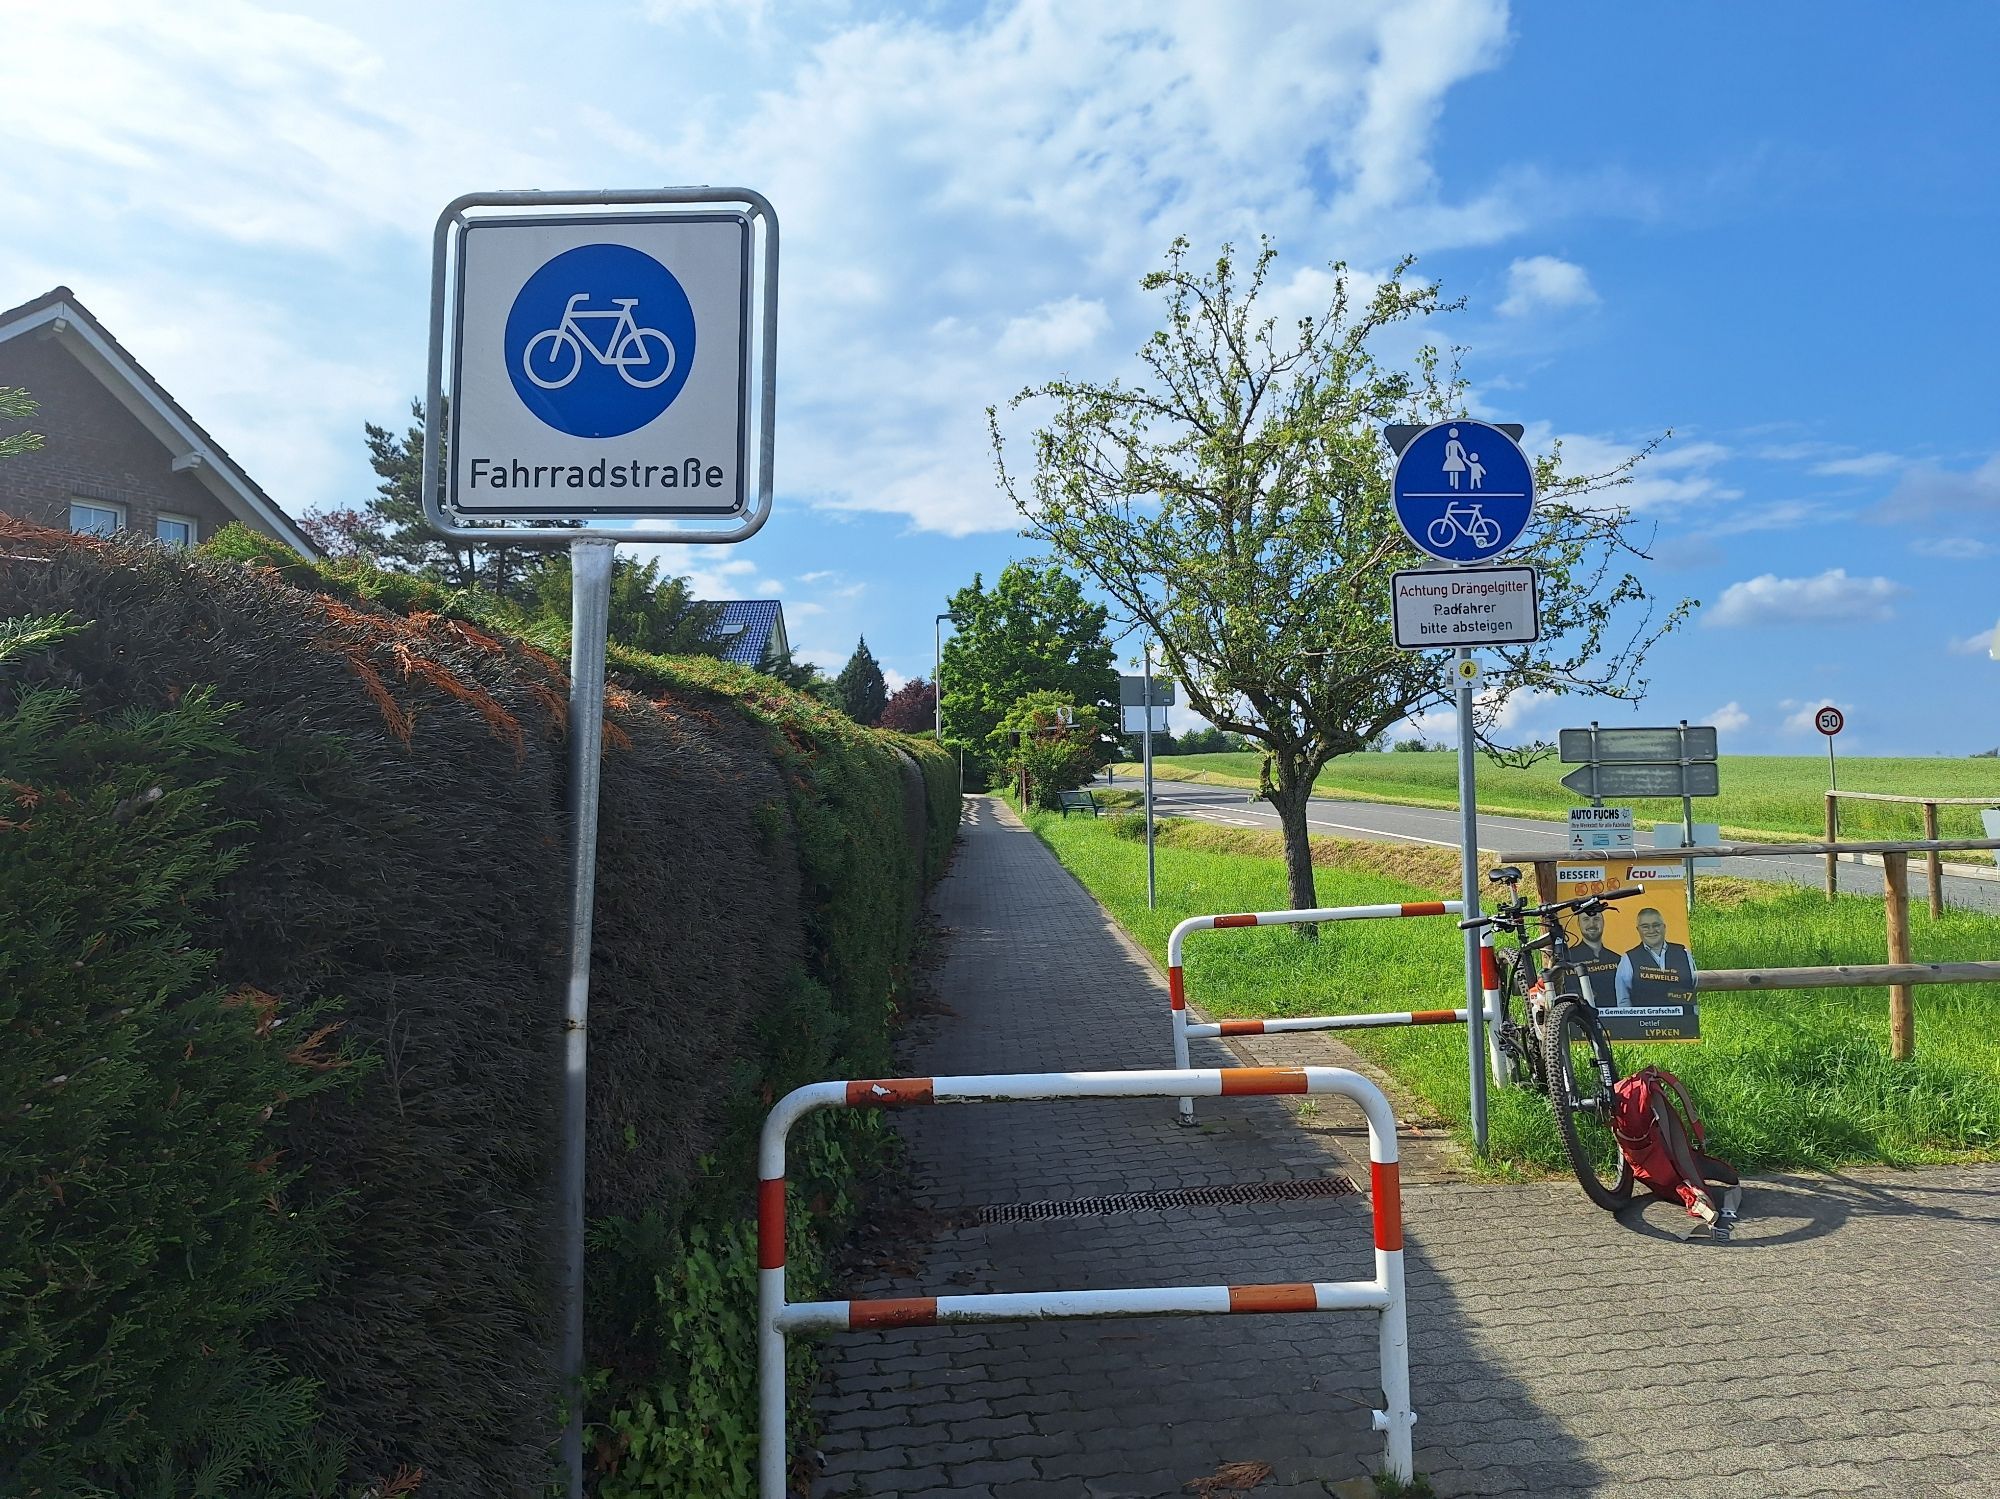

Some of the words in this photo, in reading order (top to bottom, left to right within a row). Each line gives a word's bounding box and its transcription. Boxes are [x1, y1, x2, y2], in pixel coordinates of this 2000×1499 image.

[470, 457, 724, 489] Fahrradstraße
[1400, 585, 1448, 598] Achtung
[1452, 580, 1528, 597] Drängelgitter
[1420, 622, 1448, 635] bitte
[1452, 620, 1513, 634] absteigen
[1822, 715, 1838, 728] 50
[1571, 809, 1592, 820] AUTO
[1593, 808, 1620, 820] FUCHS
[1559, 870, 1599, 880] BESSER!
[1632, 870, 1657, 879] CDU
[1640, 972, 1680, 983] KARWEILER
[1683, 992, 1693, 1002] 17
[1647, 1007, 1681, 1015] Grafschaft
[1645, 1028, 1680, 1037] LYPKEN
